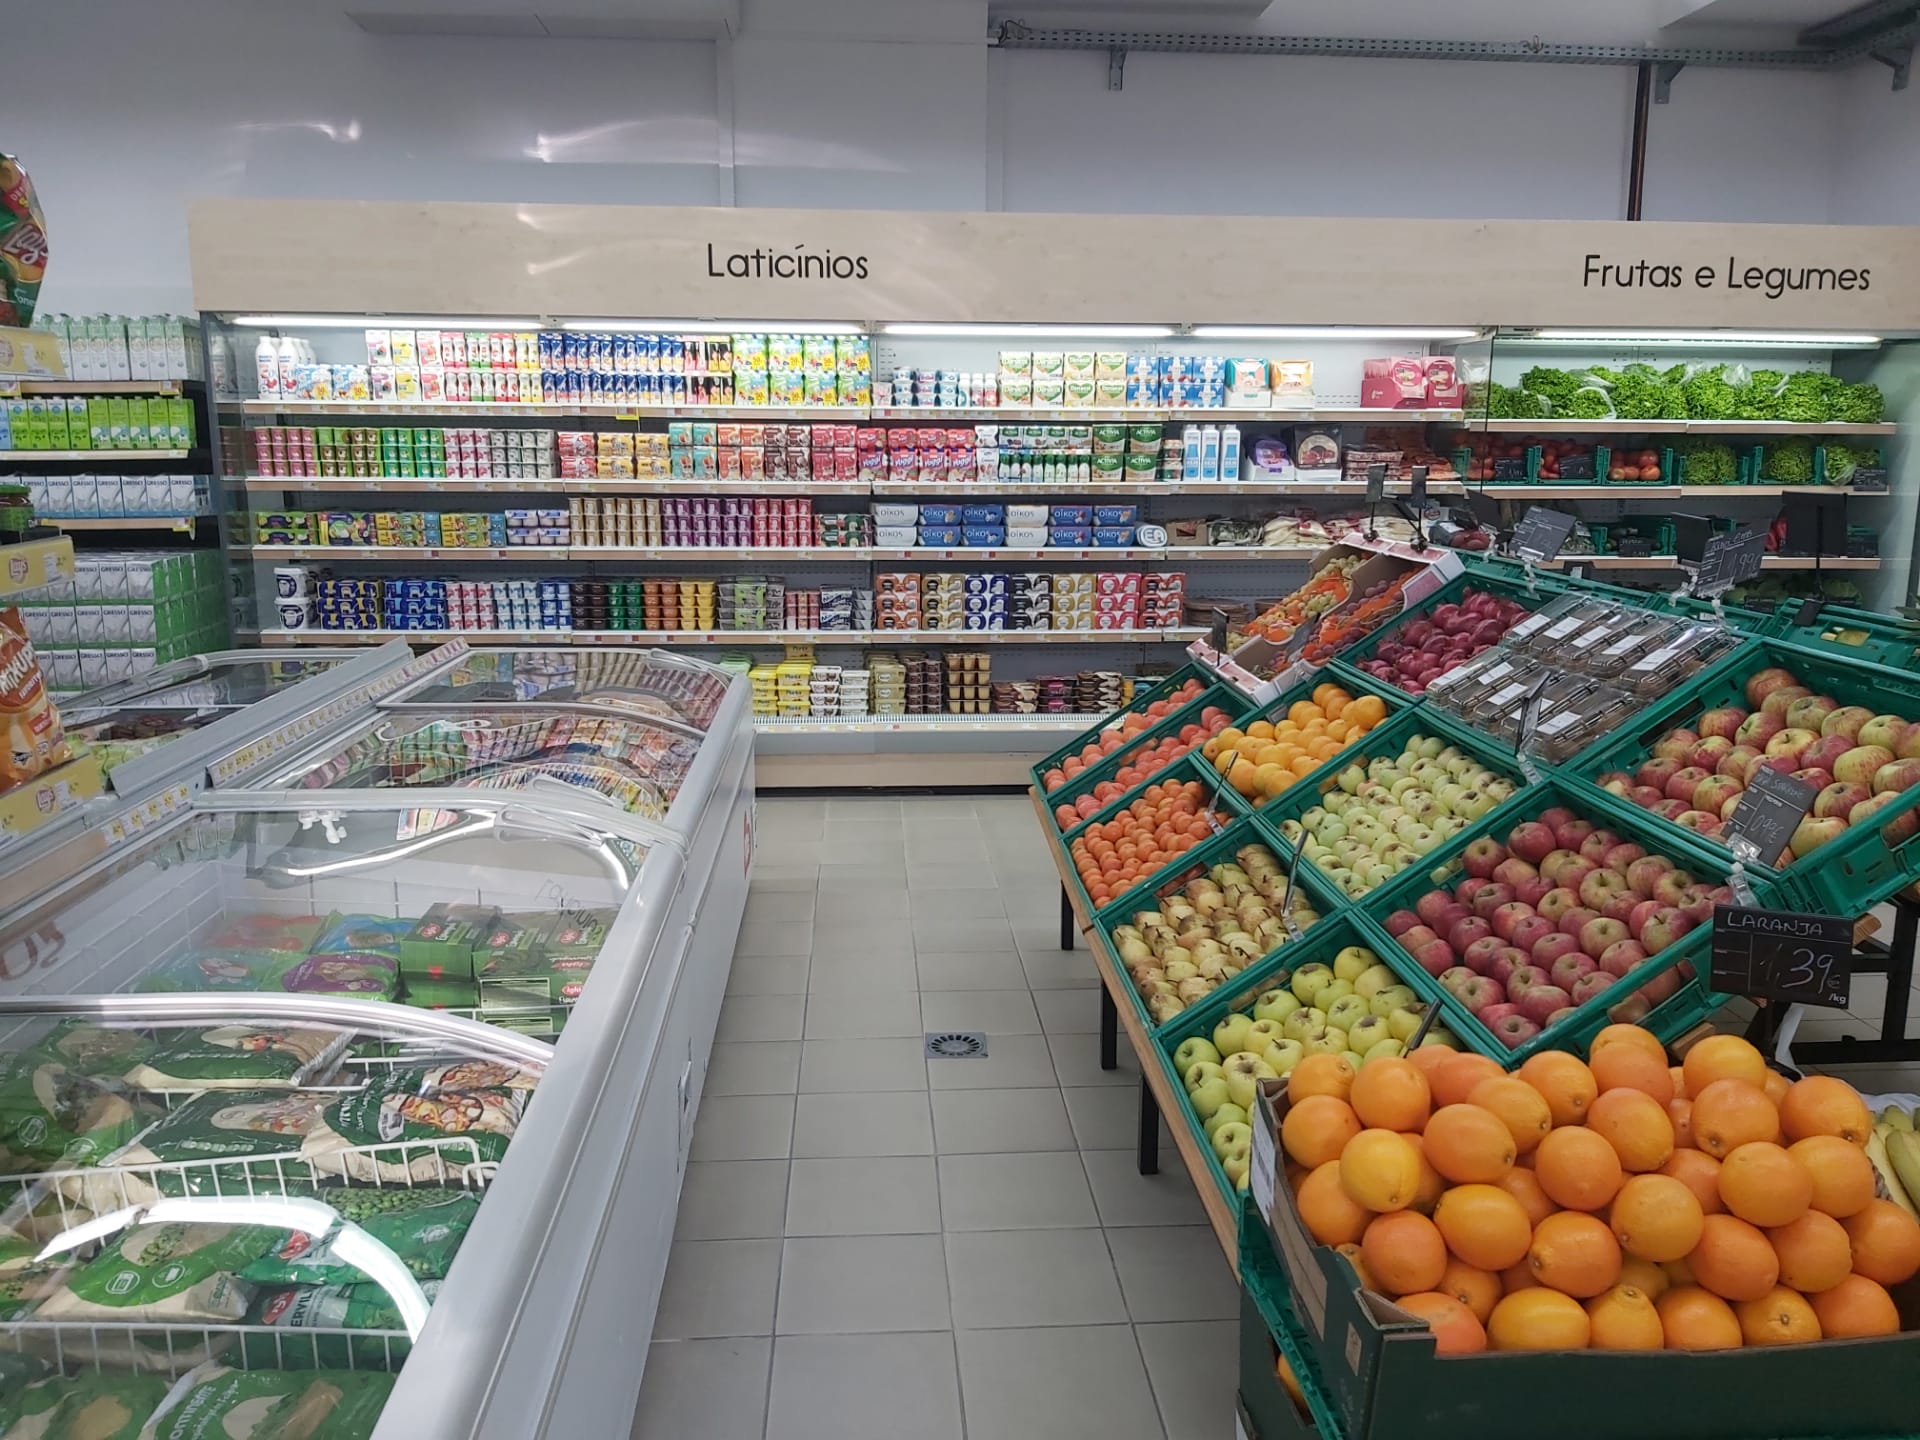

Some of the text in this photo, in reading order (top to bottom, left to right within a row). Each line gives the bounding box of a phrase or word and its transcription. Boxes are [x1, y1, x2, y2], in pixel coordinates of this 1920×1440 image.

[707, 242, 869, 280] Laticínios
[1583, 253, 1871, 300] Frutas e Legumes
[1727, 911, 1824, 936] LARANJA
[1828, 993, 1847, 1006] /kg
